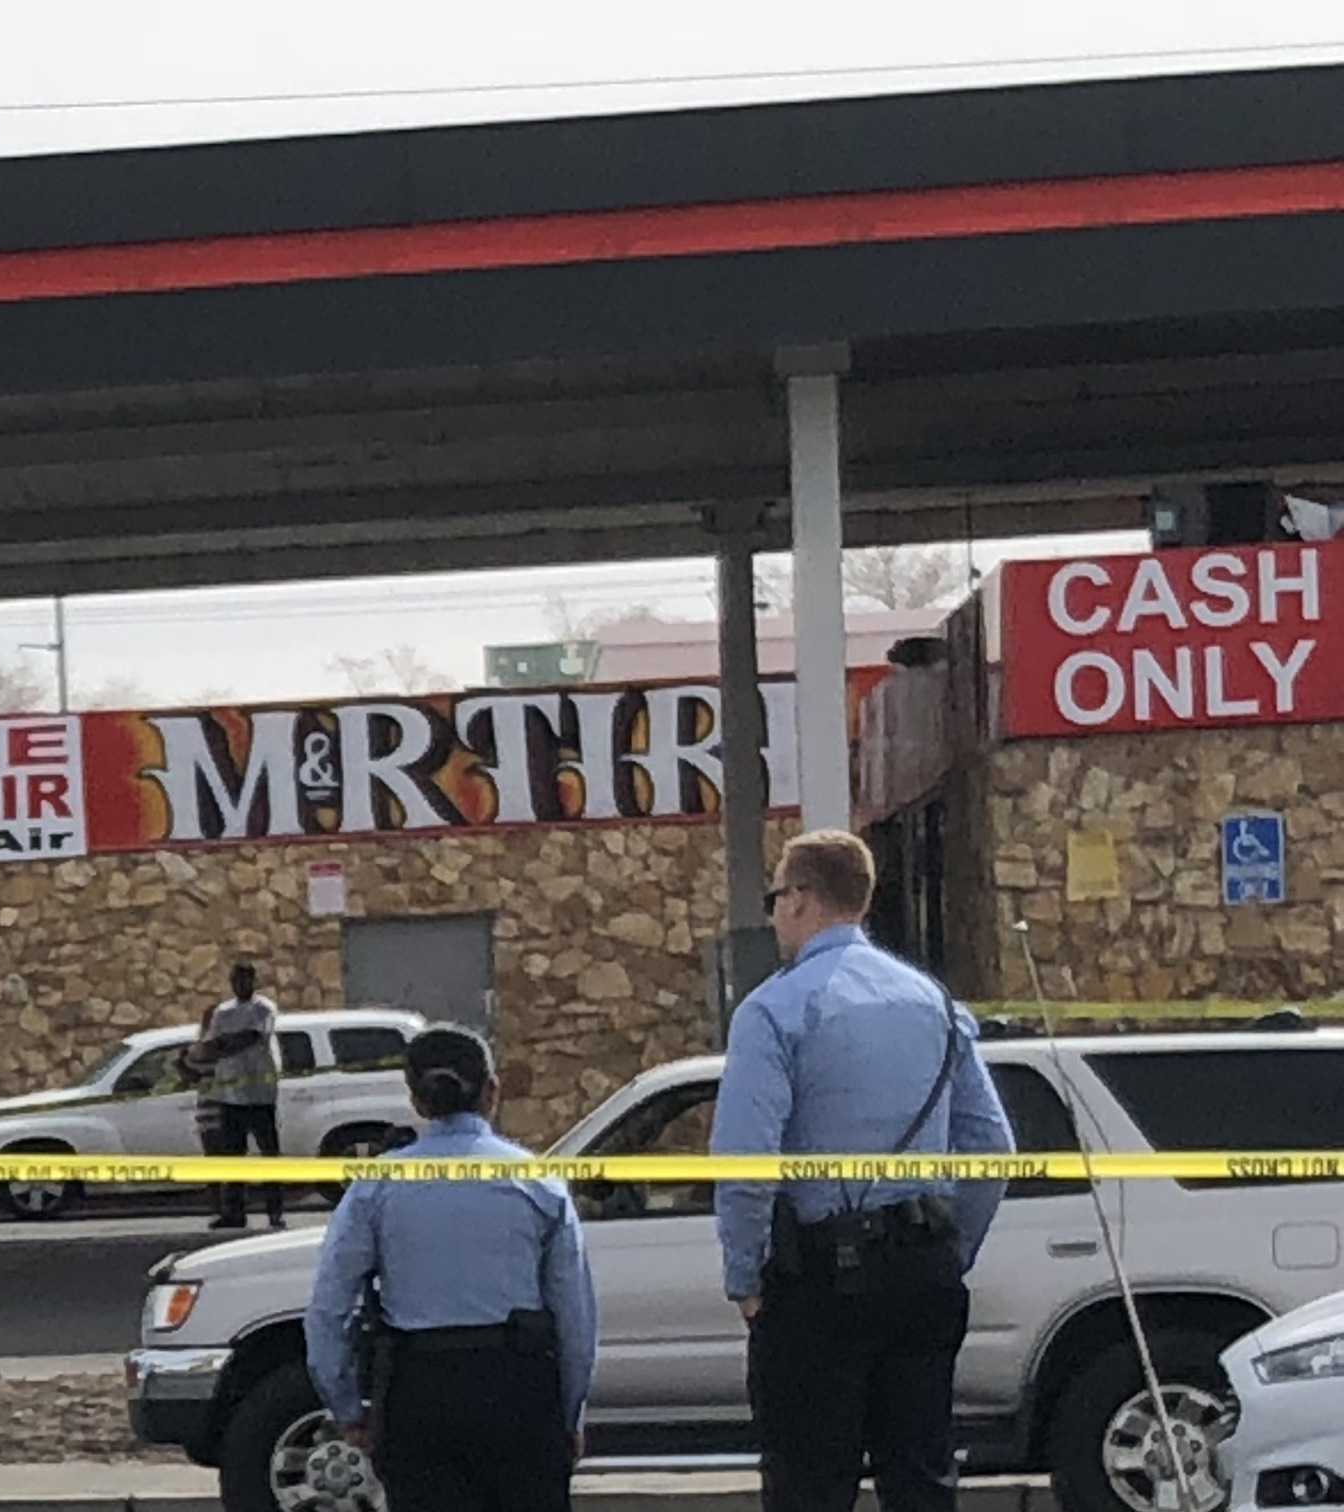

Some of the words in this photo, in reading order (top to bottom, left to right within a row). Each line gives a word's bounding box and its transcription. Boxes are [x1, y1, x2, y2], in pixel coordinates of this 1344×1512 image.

[1047, 547, 1321, 636] CASH
[1054, 639, 1317, 726] ONLY
[778, 1159, 843, 1179] CROSS
[851, 1159, 888, 1179] NOT
[893, 1159, 920, 1179] DO
[931, 1159, 972, 1179] LINE
[978, 1159, 1050, 1179] POLICE
[1226, 1156, 1292, 1178] CROSS
[1297, 1156, 1341, 1178] NOT
